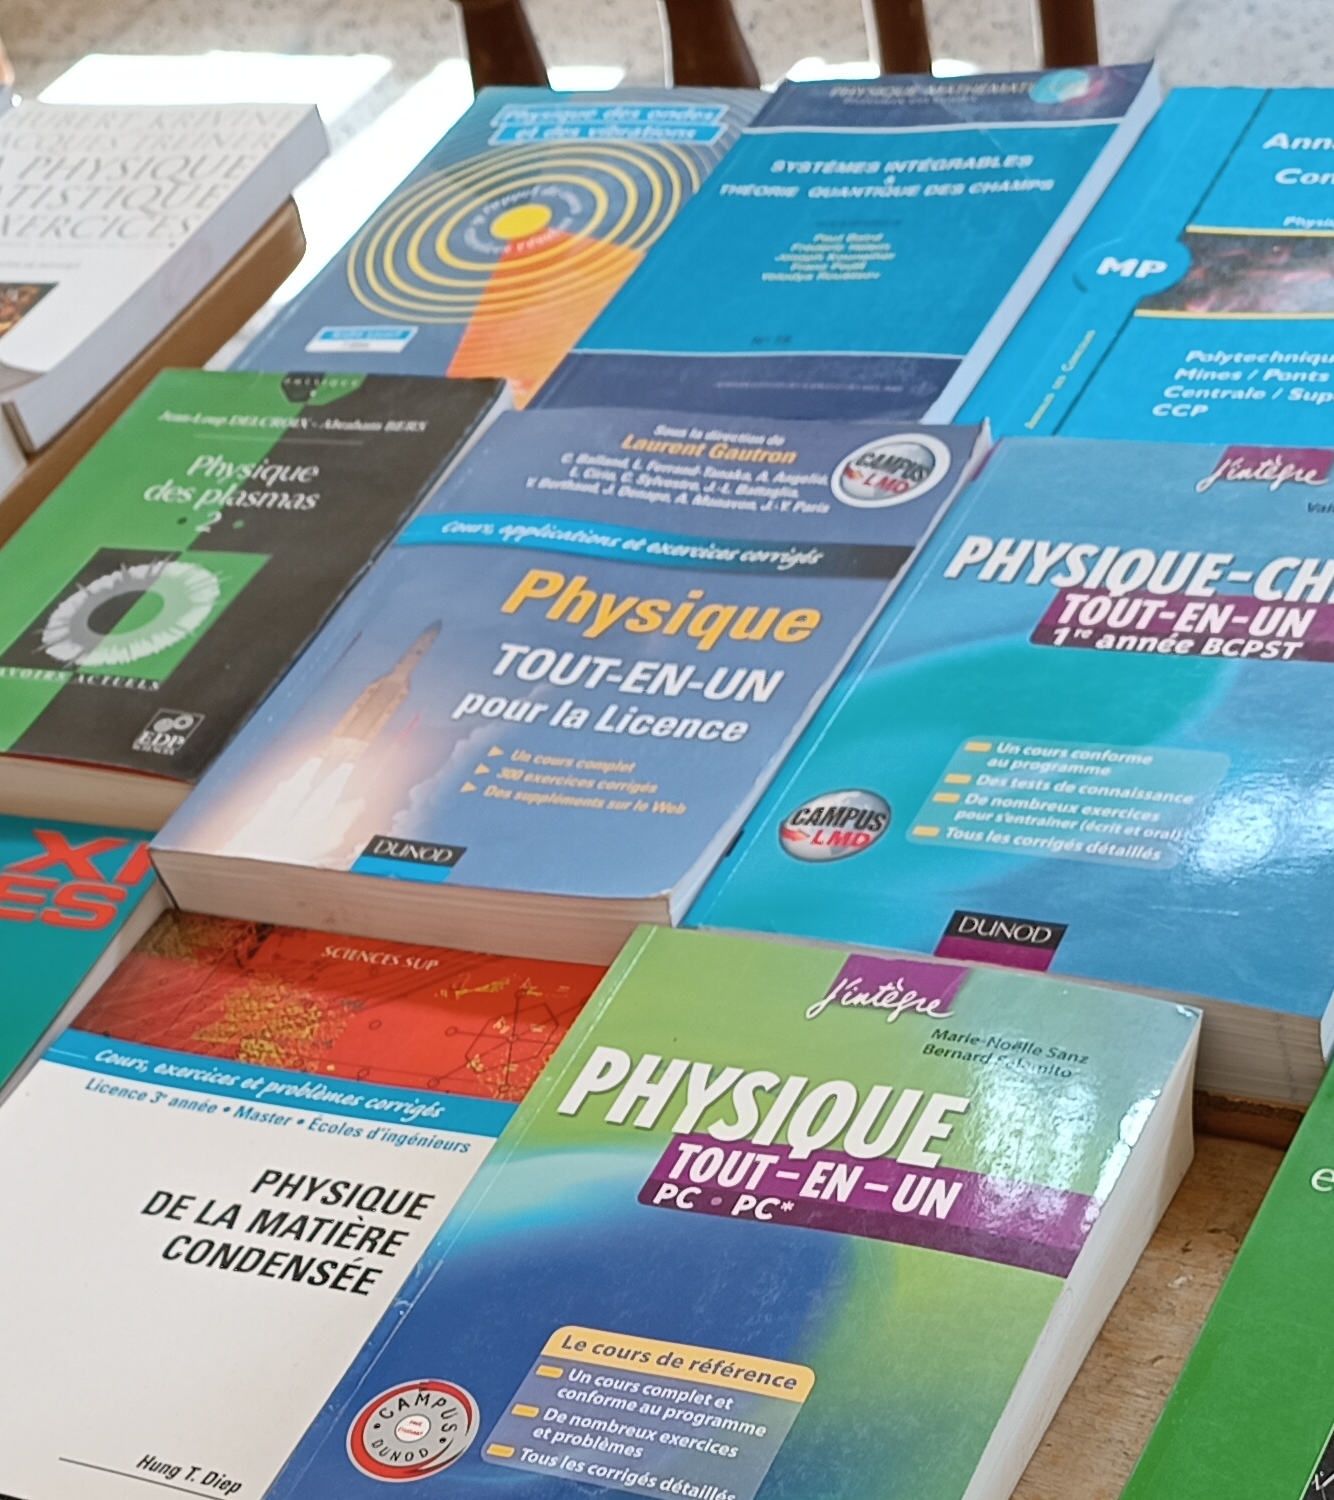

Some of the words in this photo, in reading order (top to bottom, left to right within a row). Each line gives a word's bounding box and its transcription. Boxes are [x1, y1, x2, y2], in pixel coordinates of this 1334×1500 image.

[771, 161, 880, 175] SYSTÈMES
[884, 156, 1034, 175] INTÉGRABLES
[719, 184, 800, 197] THÉORIE
[807, 185, 921, 200] QUANTIQUE
[925, 183, 966, 197] DES
[970, 180, 1055, 195] CHAMPS
[1096, 255, 1168, 279] MP
[1151, 402, 1210, 419] CCP
[186, 454, 319, 483] Physique
[621, 434, 706, 457] Laurent
[709, 443, 798, 464] Gautron
[143, 479, 193, 504] des
[199, 486, 319, 510] plasmas
[500, 568, 823, 653] Physique
[1055, 593, 1318, 639] TOUT-EN-UN
[1097, 627, 1195, 656] année
[1200, 635, 1304, 661] BCPST
[491, 642, 785, 704] TOUT-EN-UN
[452, 690, 549, 728] pour
[557, 700, 591, 728] la
[599, 702, 749, 744] Licence
[945, 826, 984, 843] Tous
[985, 830, 1010, 845] les
[1020, 834, 1084, 854] corrigés
[1086, 840, 1162, 862] détaillés
[555, 1044, 972, 1171] PHYSIQUE
[249, 1168, 437, 1223] PHYSIQUE
[141, 1188, 194, 1219] DE
[194, 1200, 242, 1231] LA
[246, 1205, 410, 1261] MATIÈRE
[161, 1233, 385, 1299] CONDENSÉE
[561, 1335, 588, 1352] Le
[592, 1342, 651, 1364] cours
[656, 1351, 684, 1368] de
[689, 1359, 798, 1390] référence
[135, 1452, 181, 1481] Hung
[185, 1463, 198, 1484] T.
[199, 1468, 243, 1498] Diep
